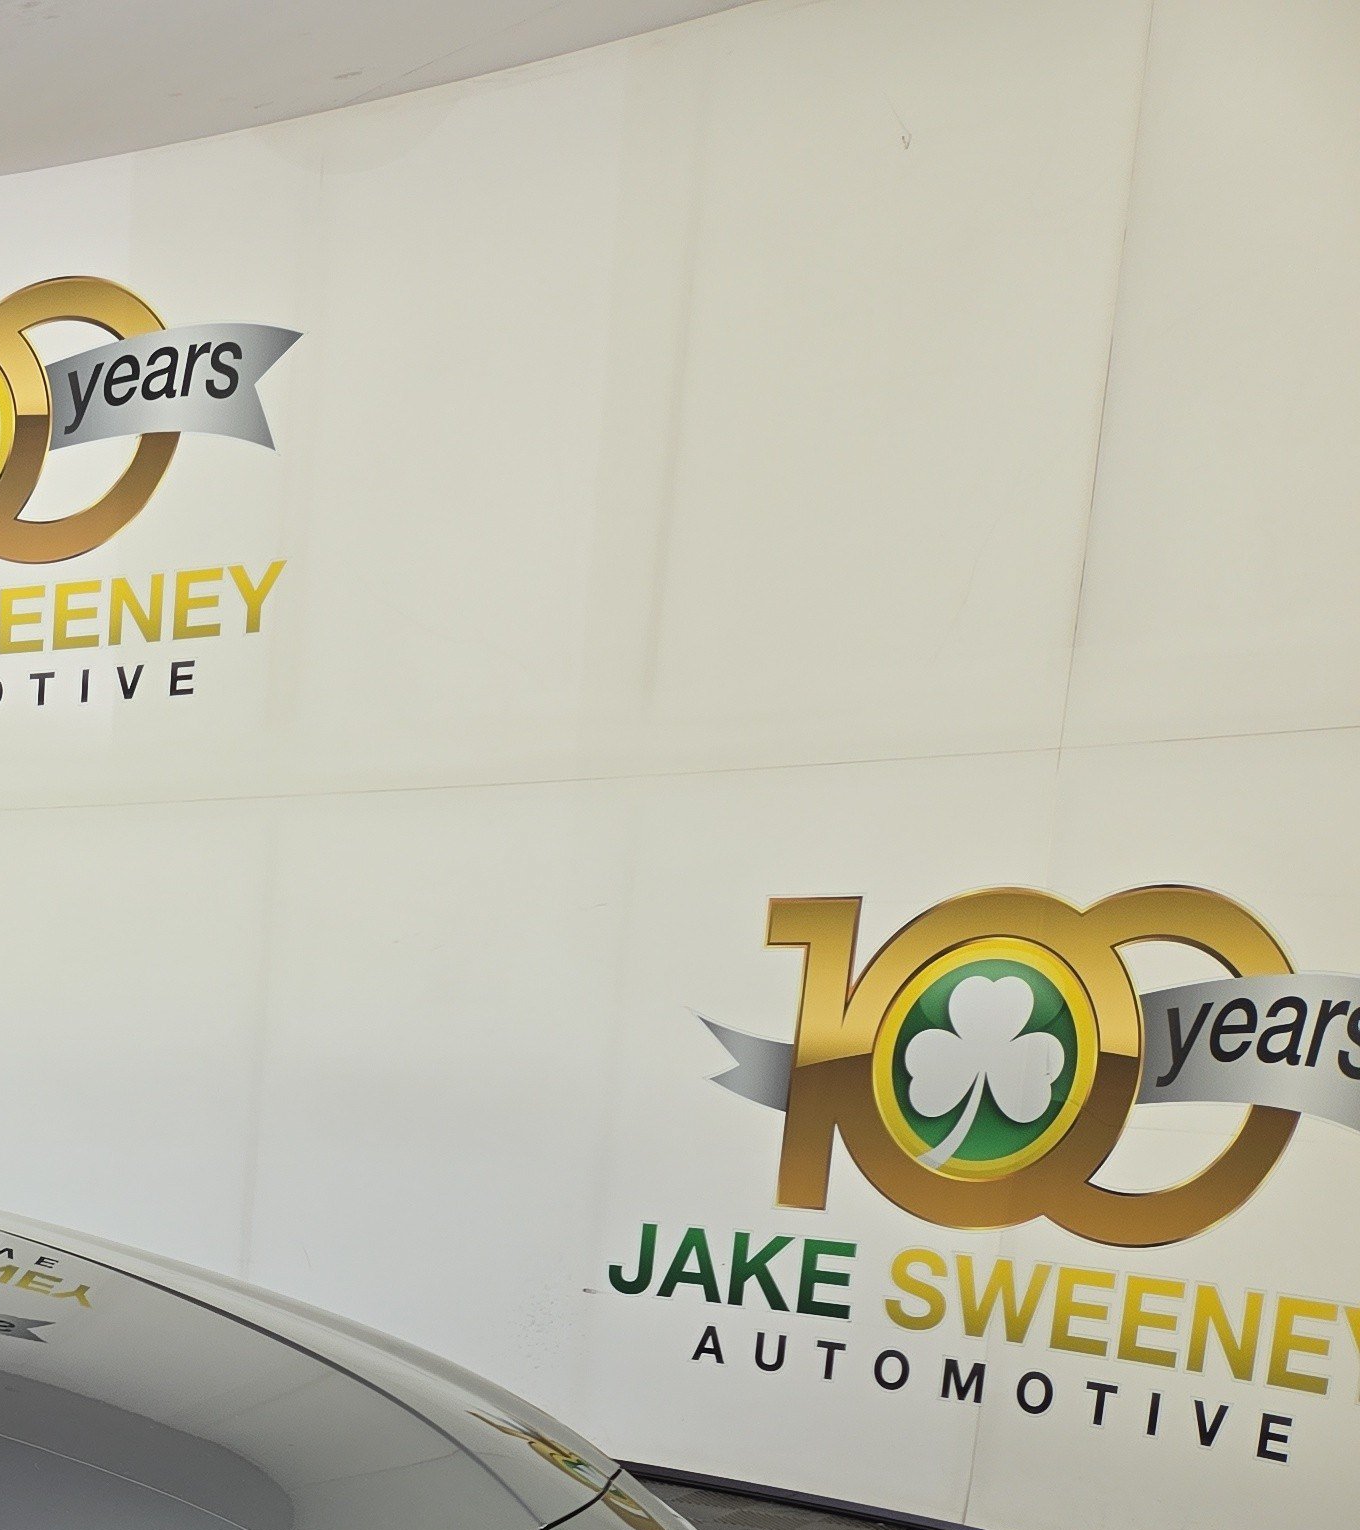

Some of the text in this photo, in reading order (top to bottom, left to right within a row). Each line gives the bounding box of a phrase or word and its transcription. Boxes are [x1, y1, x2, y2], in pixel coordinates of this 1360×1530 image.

[64, 339, 243, 435] years
[765, 884, 1302, 1248] 100
[608, 1222, 1360, 1404] JAKE SWEENE
[691, 1325, 1293, 1463] AUTOMOTIVE
